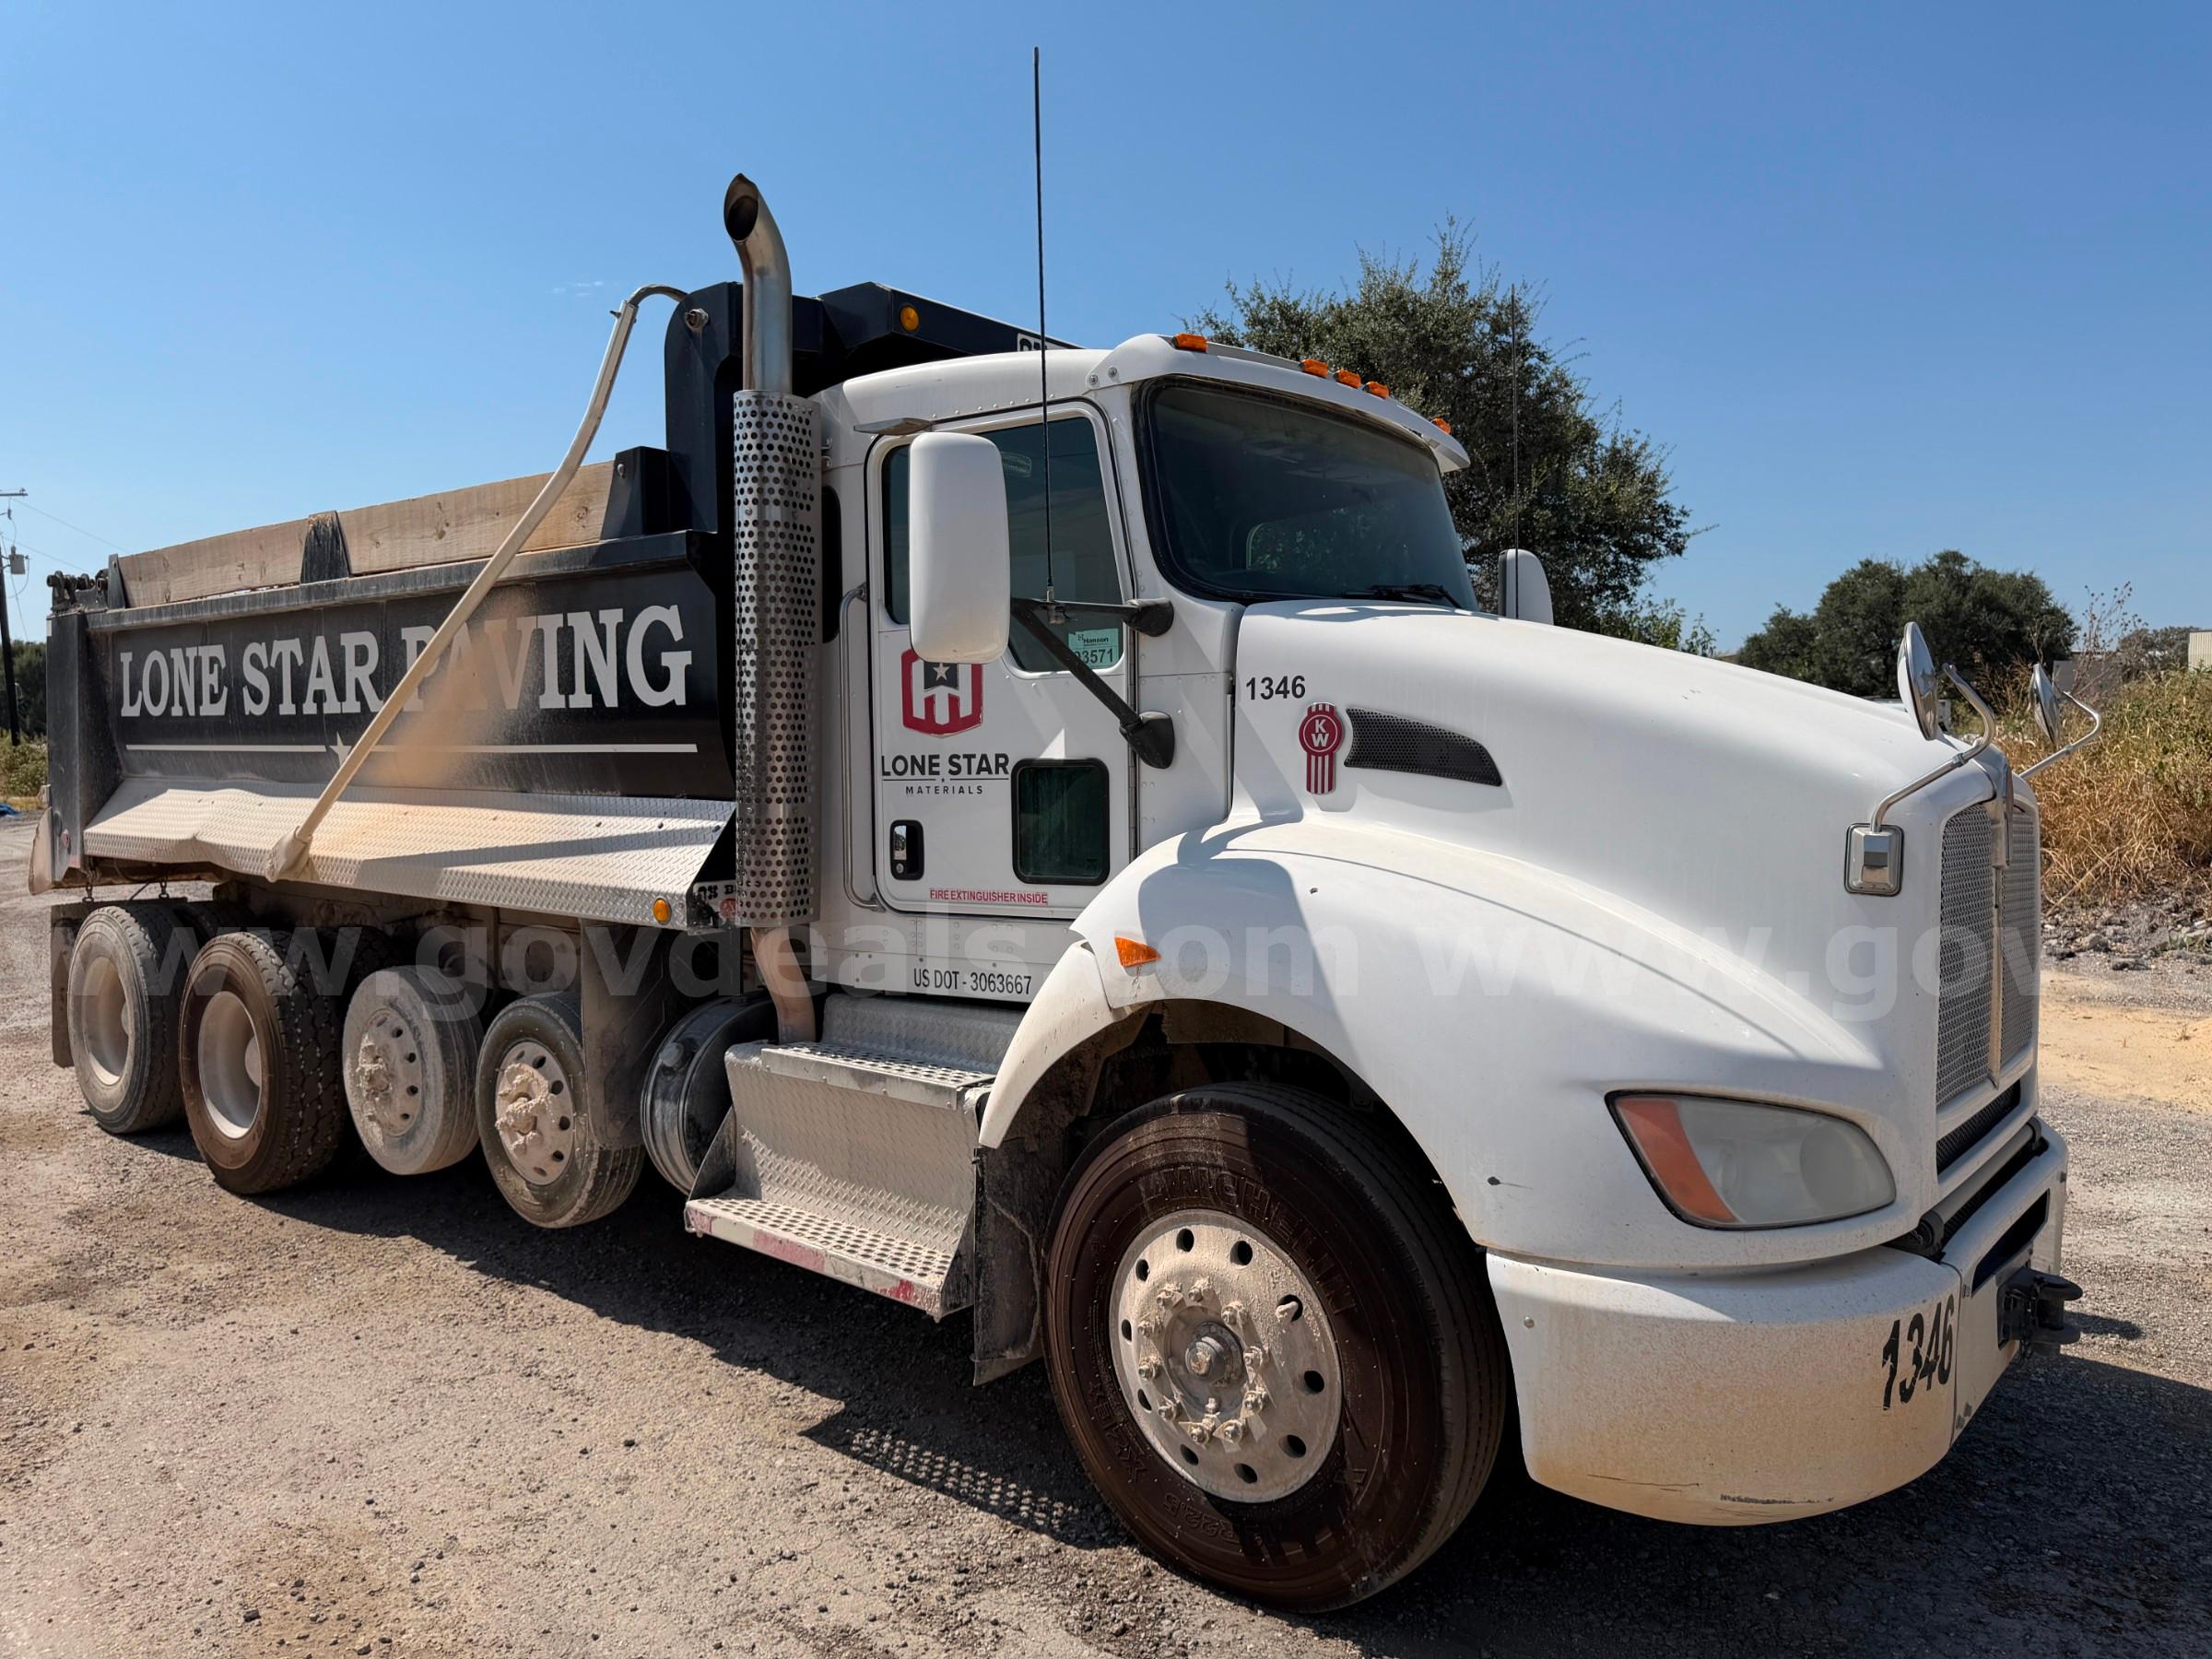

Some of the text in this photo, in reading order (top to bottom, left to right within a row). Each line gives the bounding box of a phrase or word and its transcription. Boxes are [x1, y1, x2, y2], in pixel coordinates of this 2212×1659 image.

[1083, 636, 1109, 644] Hanson
[120, 604, 692, 717] LONE STAR PAVING
[1246, 676, 1305, 700] 1346
[881, 753, 1009, 776] LONE STAR
[905, 785, 983, 794] MATERIALS
[930, 889, 1048, 903] FIRE EXTINGUISHER INSIDE
[913, 968, 930, 987] US
[935, 970, 959, 990] DOT
[970, 972, 1032, 994] 3063667
[1882, 1294, 1954, 1411] 1346
